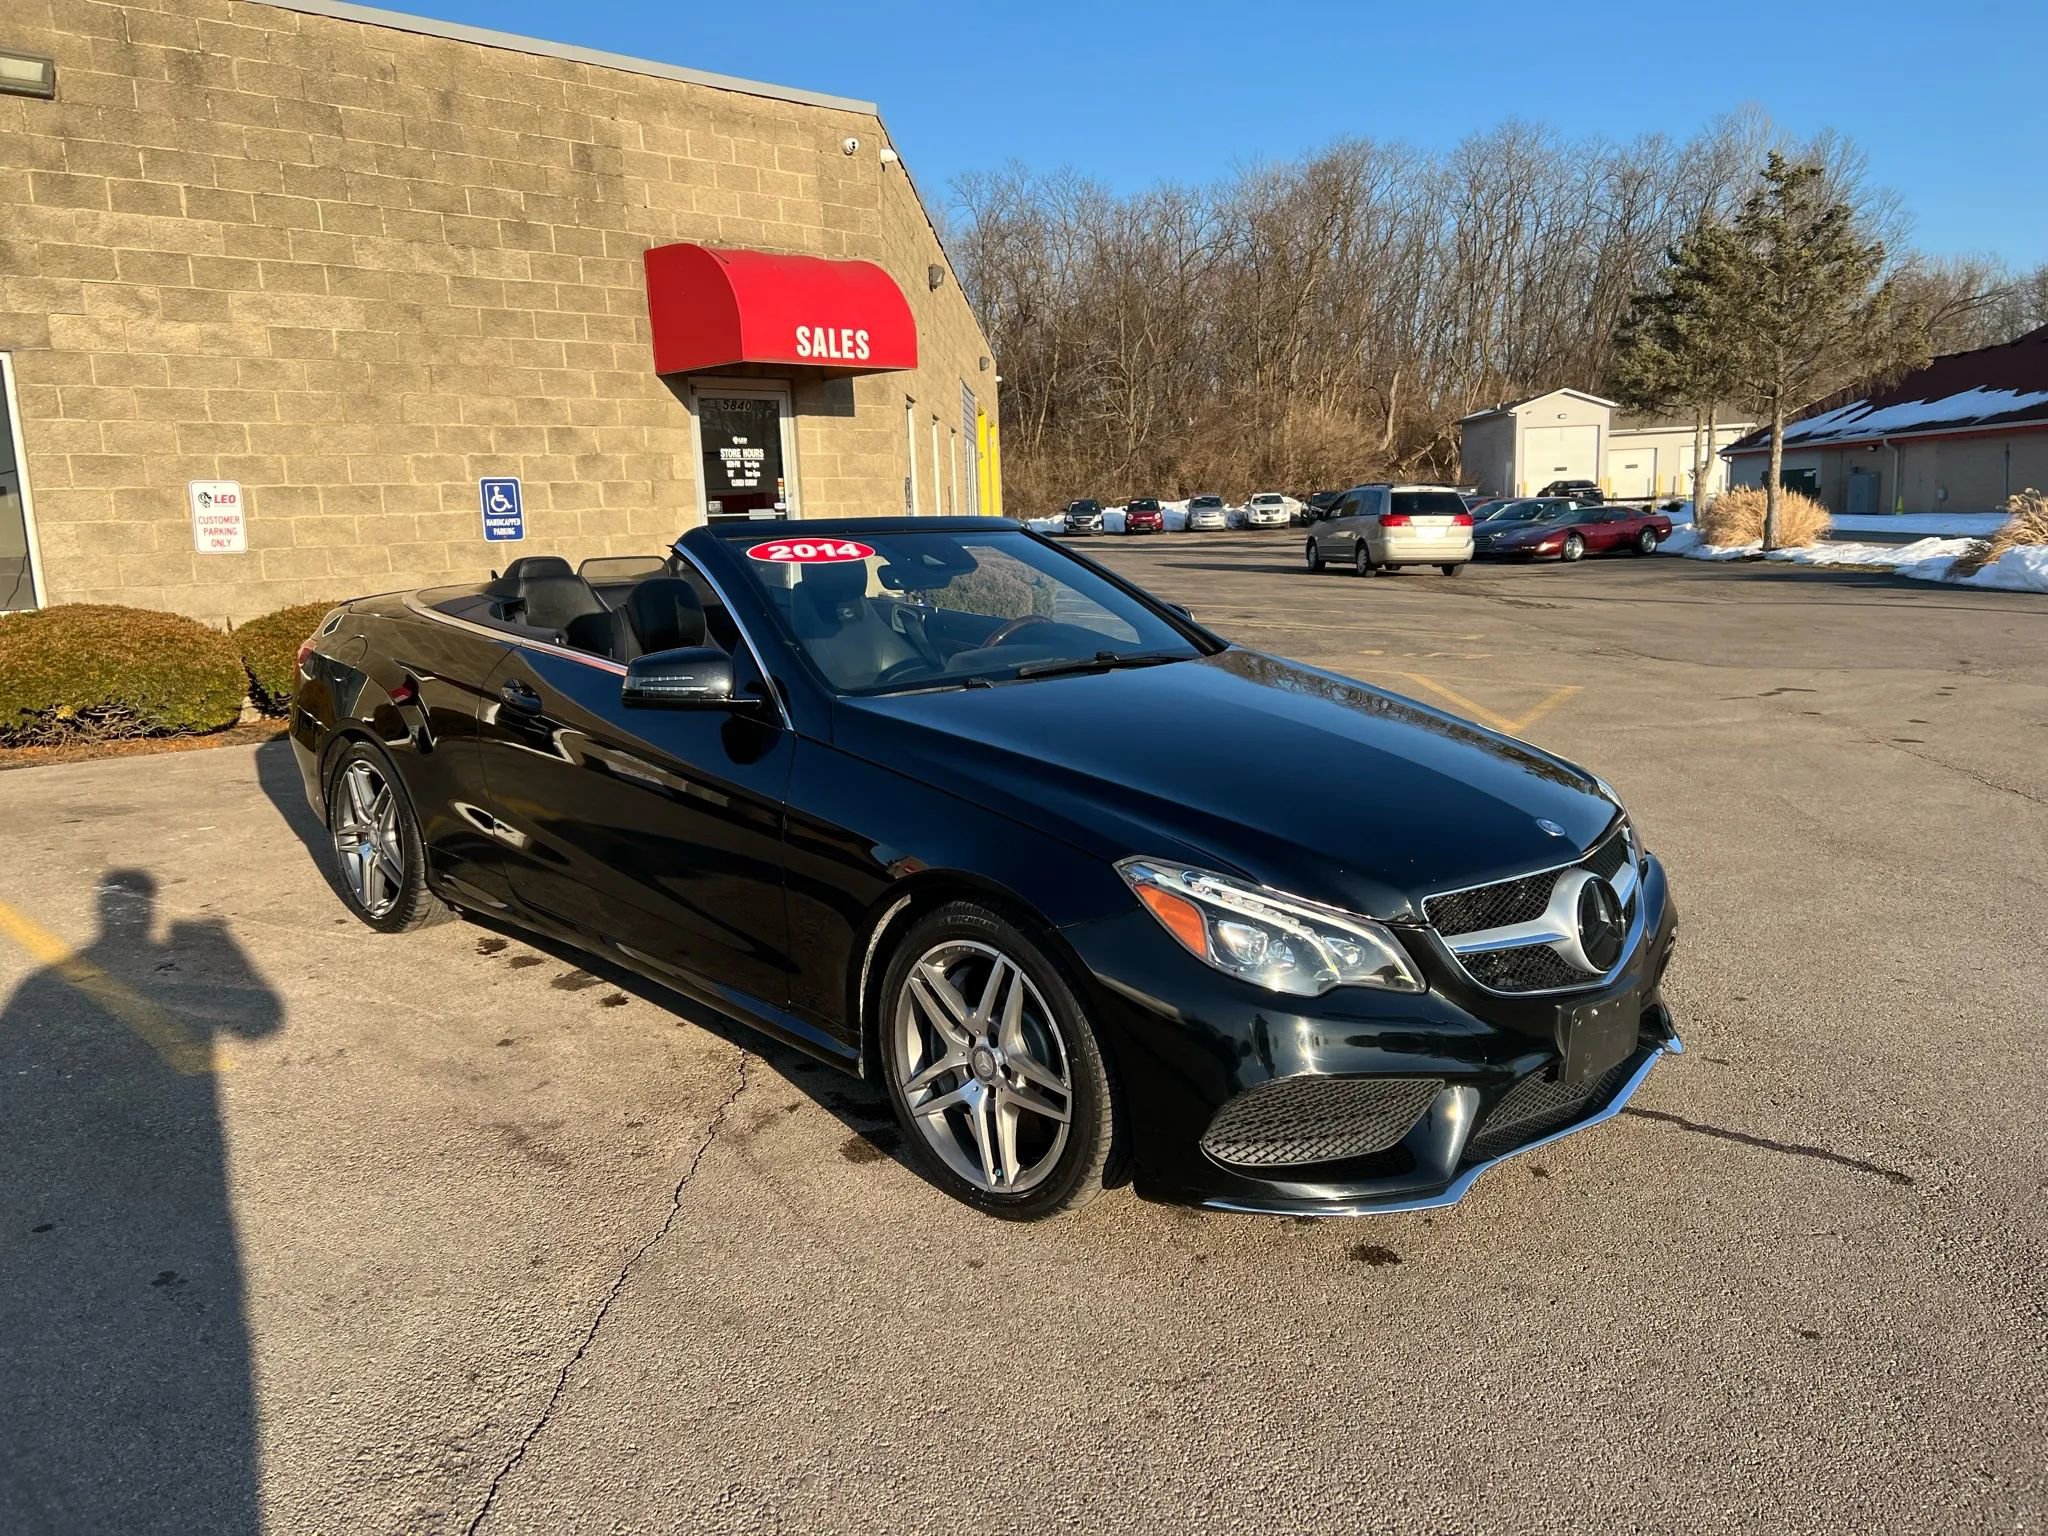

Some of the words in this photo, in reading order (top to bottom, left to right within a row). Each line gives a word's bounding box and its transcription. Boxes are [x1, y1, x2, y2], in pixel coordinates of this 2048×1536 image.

[795, 325, 870, 360] SALES
[722, 400, 752, 412] 5840
[720, 448, 742, 458] STORE
[742, 448, 764, 458] HOURS
[214, 494, 236, 504] LEO
[198, 516, 240, 525] CUSTOMER
[203, 527, 238, 537] PARKING
[211, 538, 231, 548] ONLY
[767, 543, 861, 560] 2014
